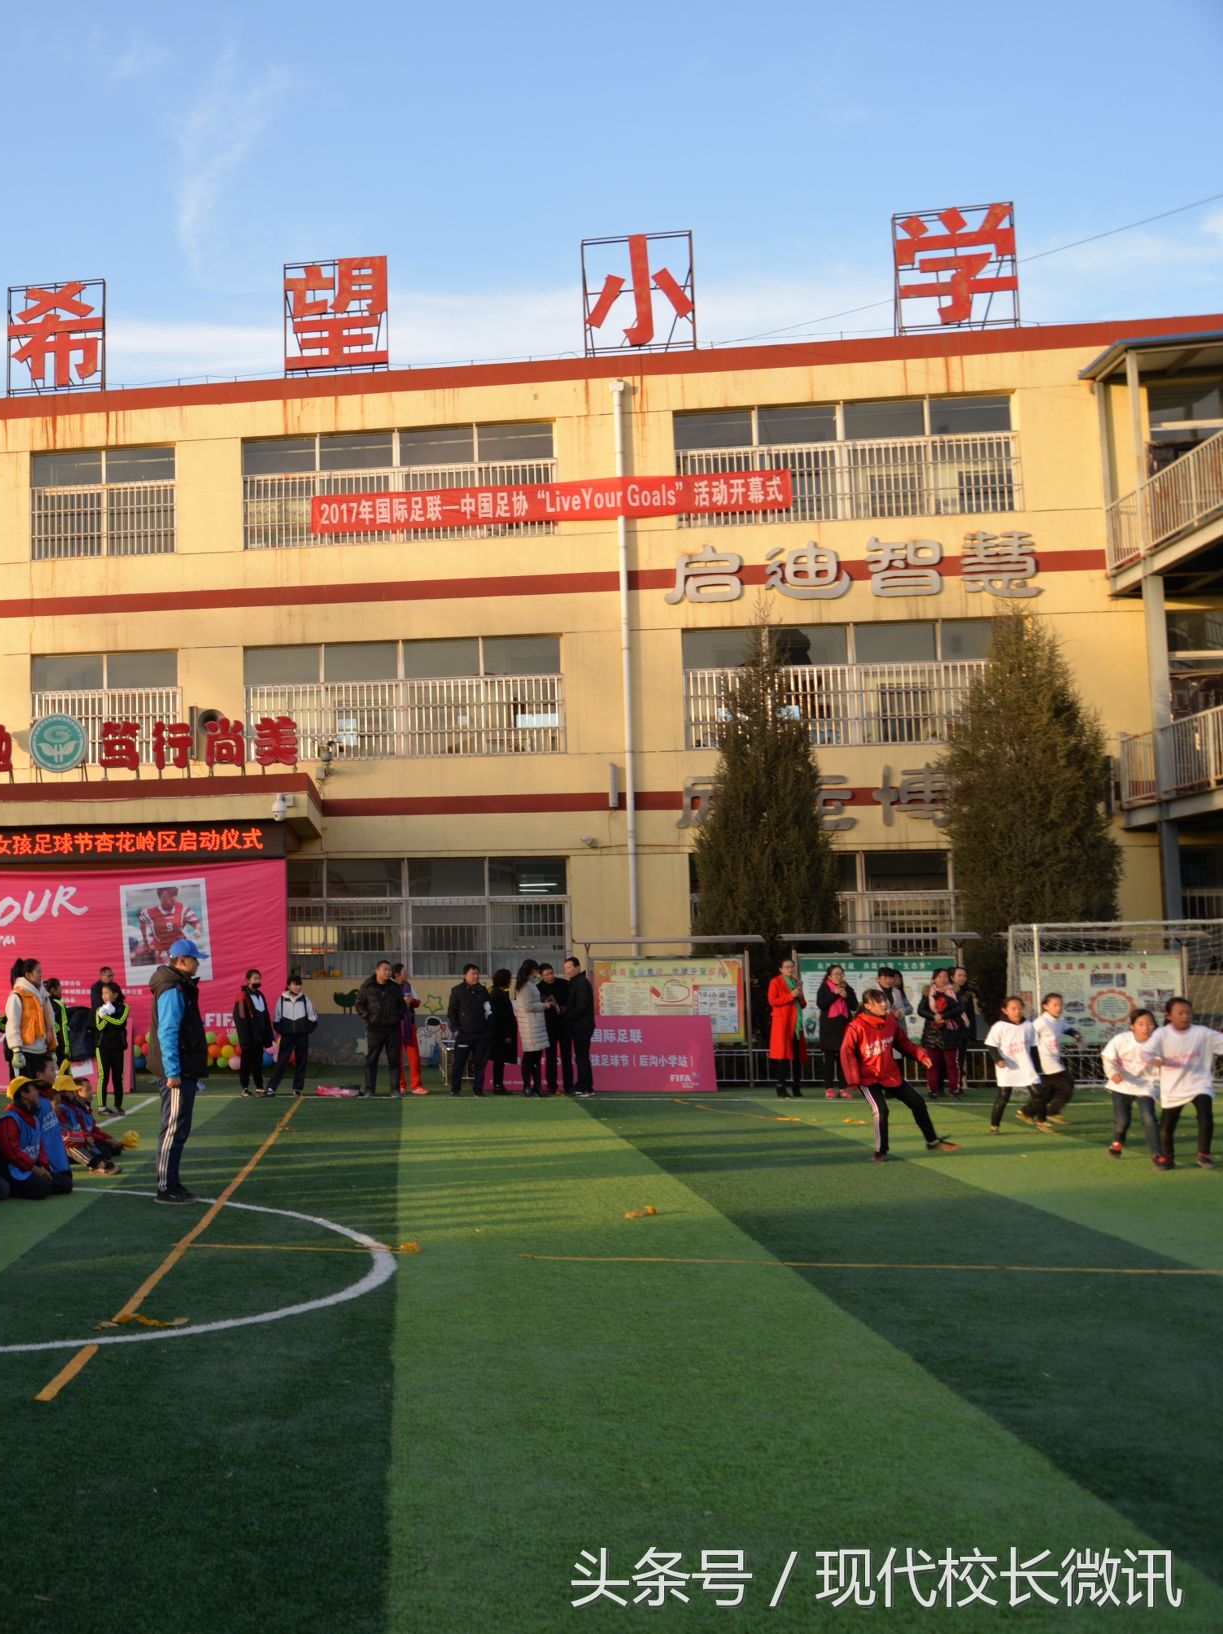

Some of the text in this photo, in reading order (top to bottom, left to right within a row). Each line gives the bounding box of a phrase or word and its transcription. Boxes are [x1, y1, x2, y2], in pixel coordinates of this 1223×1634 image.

[694, 476, 783, 507] 活动开幕式
[664, 531, 1044, 604] 启迪智慧
[100, 715, 298, 772] 笃行尚美
[670, 1074, 691, 1082] FIFA
